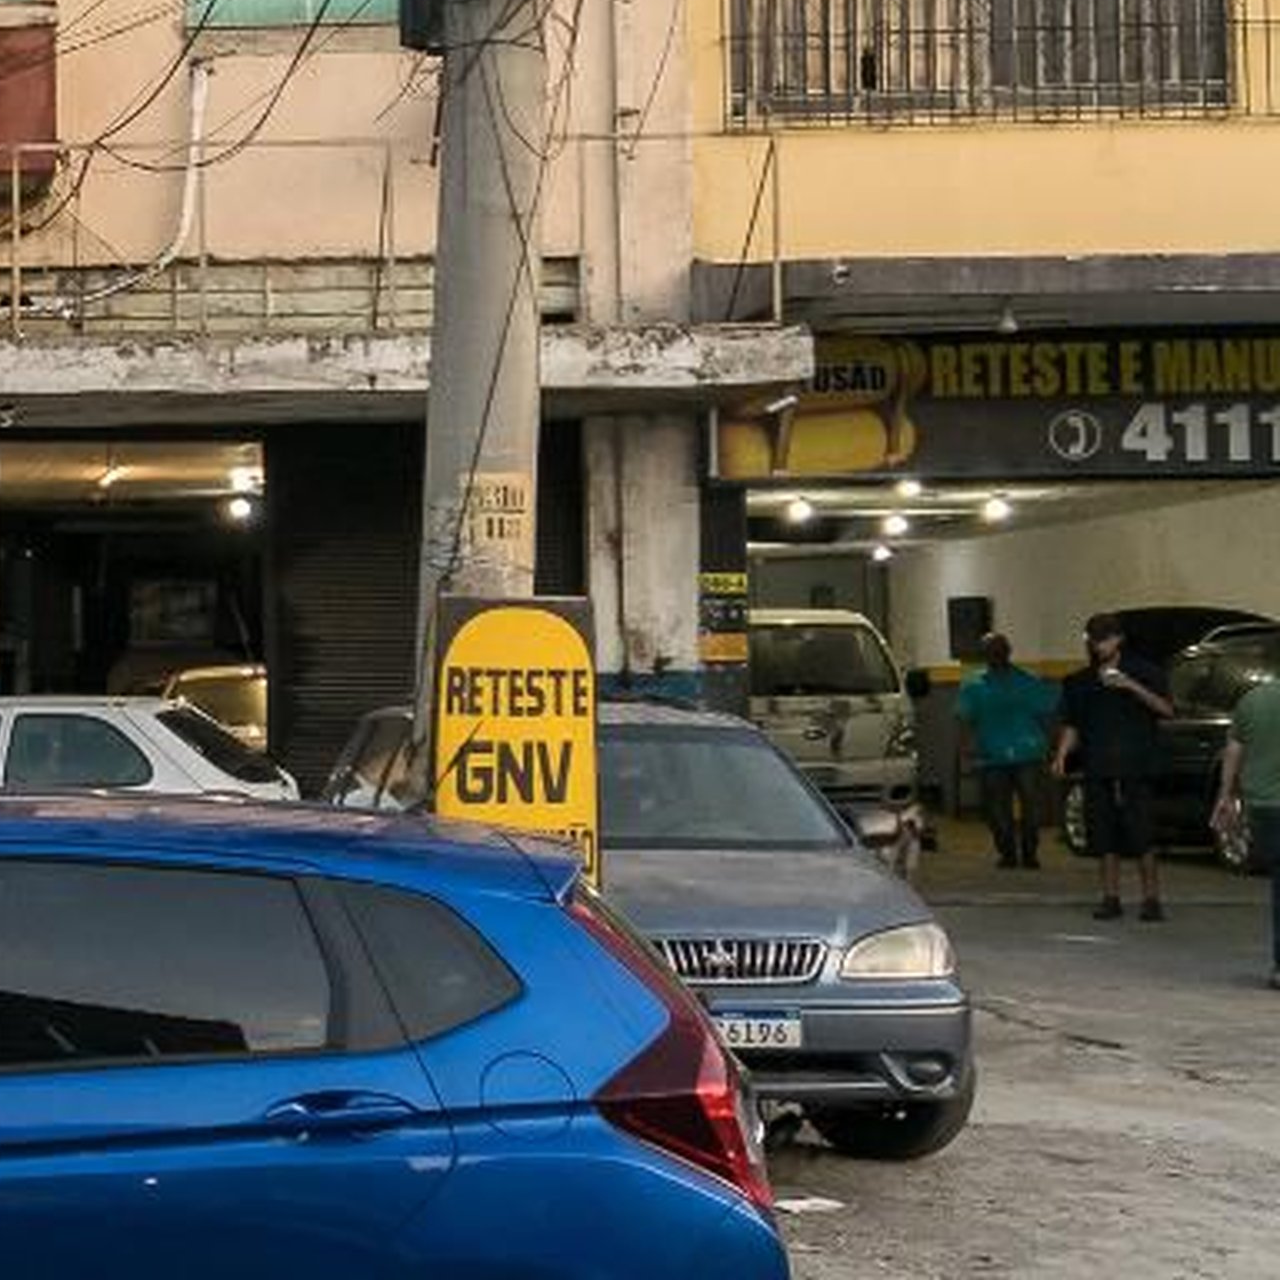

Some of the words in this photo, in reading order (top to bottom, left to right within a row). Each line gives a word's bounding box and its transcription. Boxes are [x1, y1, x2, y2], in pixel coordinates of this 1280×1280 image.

[930, 341, 1110, 397] RETESTE
[1120, 341, 1145, 393] E
[446, 665, 590, 718] RETESTE
[455, 740, 573, 805] GNV
